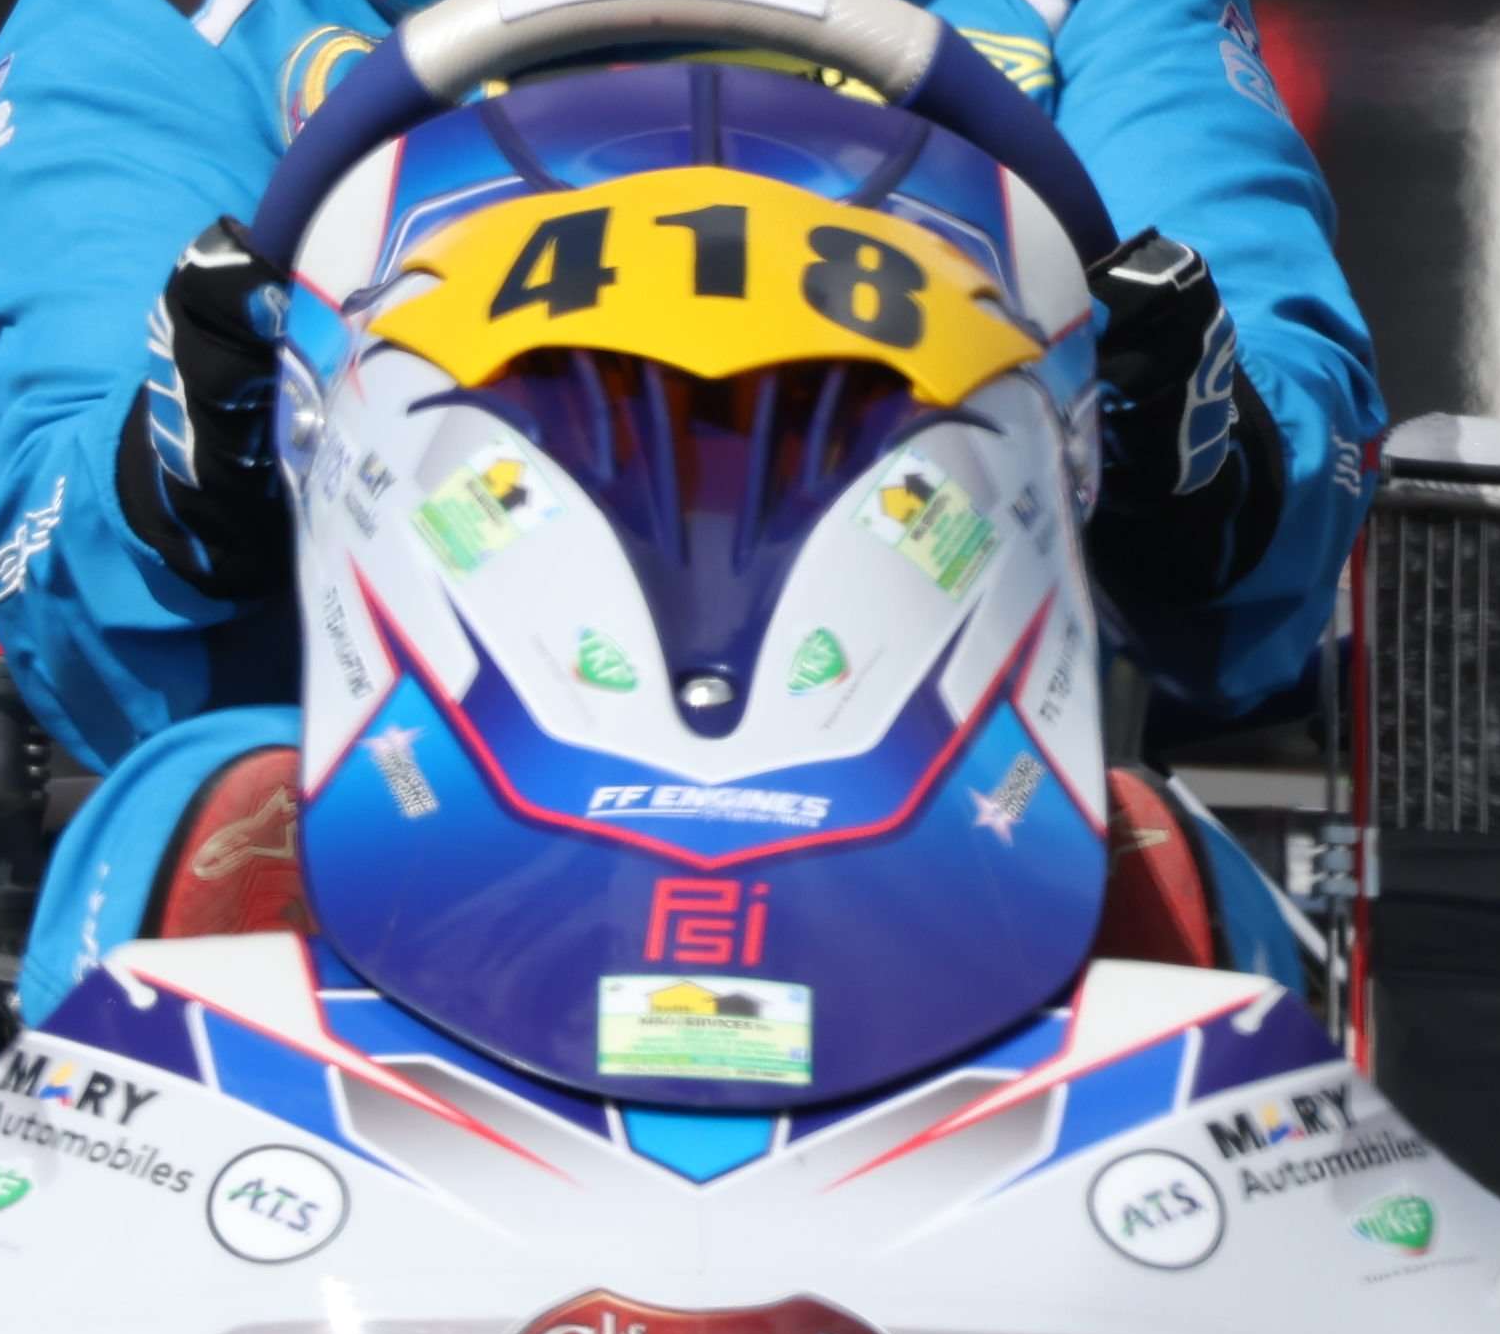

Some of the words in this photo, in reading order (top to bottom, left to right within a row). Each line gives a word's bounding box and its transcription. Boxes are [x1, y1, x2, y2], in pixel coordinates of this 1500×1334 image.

[487, 204, 929, 350] 418
[588, 785, 653, 811] FF
[650, 784, 832, 819] ENGINES
[1236, 1130, 1438, 1202] Automobiles
